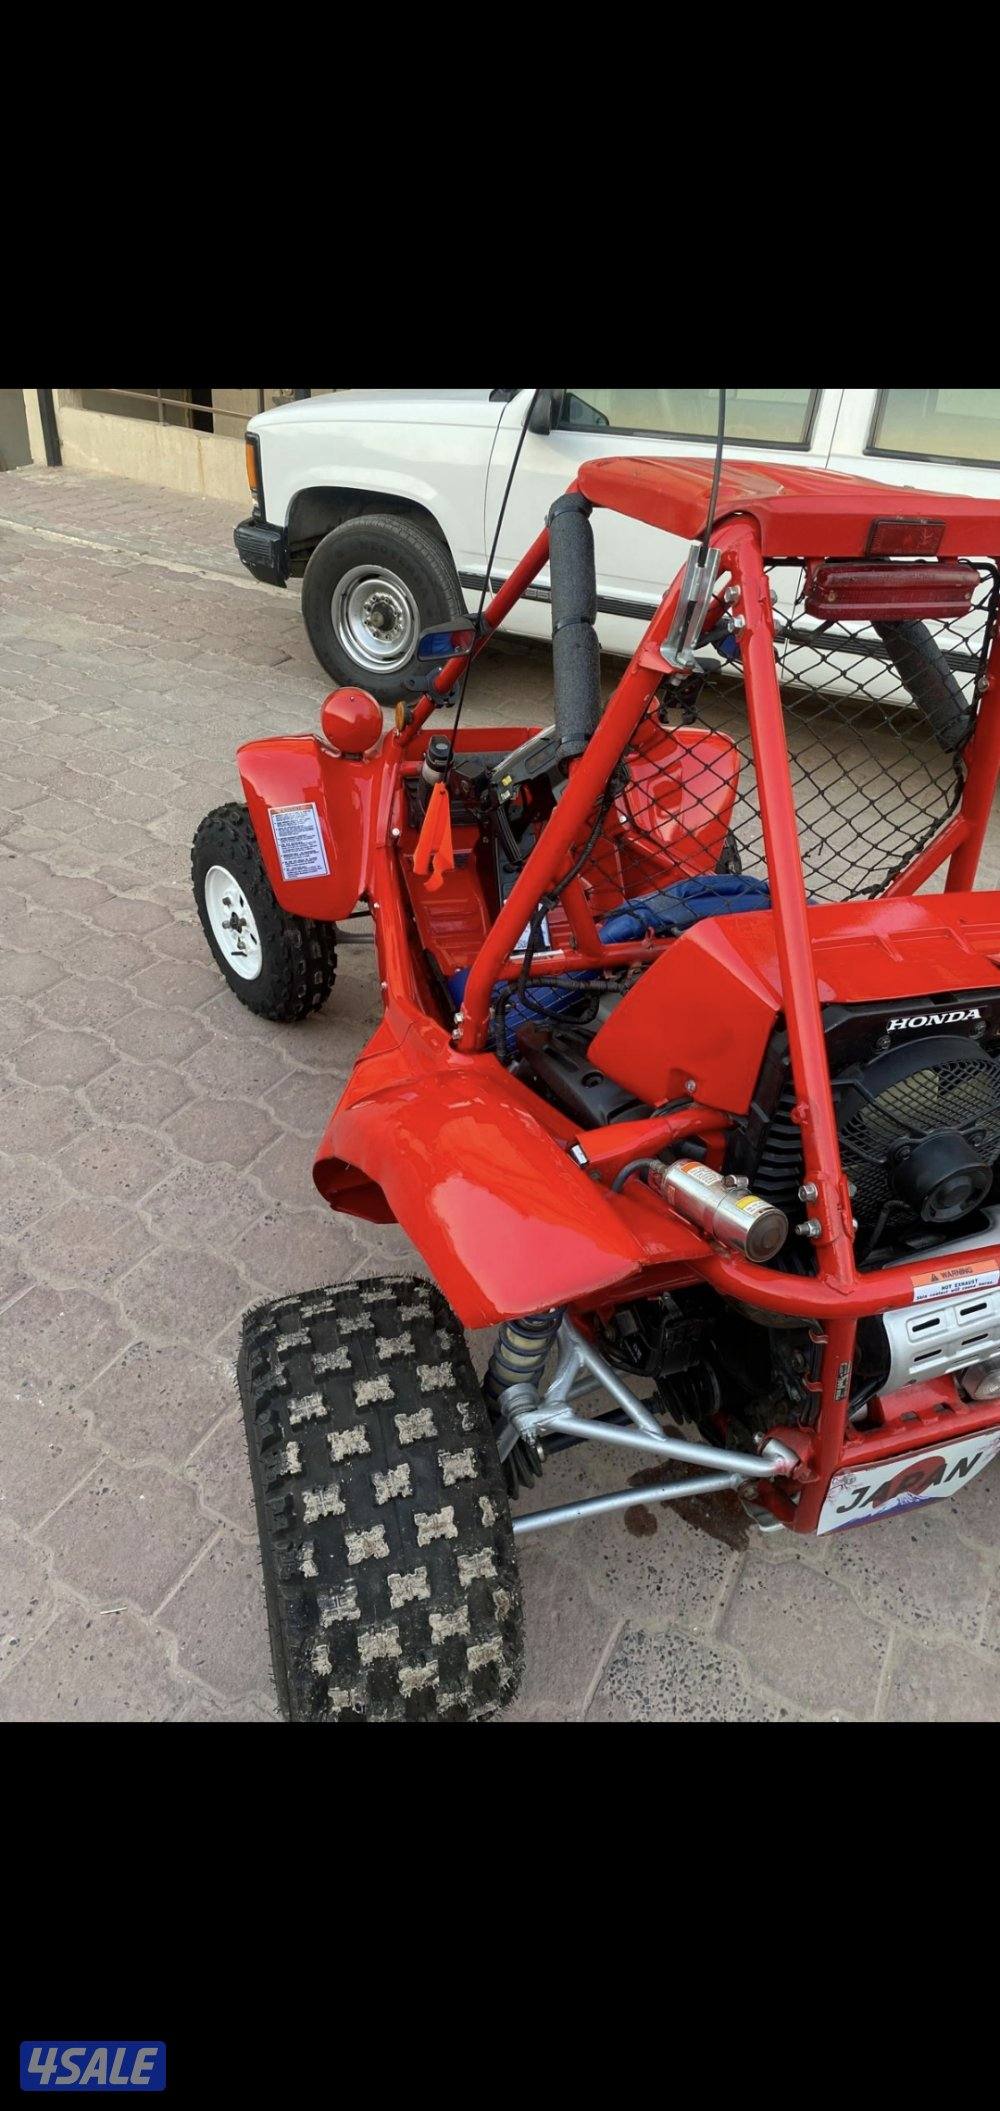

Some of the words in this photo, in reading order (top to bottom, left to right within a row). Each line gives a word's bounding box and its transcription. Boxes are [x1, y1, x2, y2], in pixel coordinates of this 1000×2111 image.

[886, 1008, 982, 1031] HONDA
[940, 1267, 974, 1279] WARNING
[836, 1451, 984, 1514] JAPAN
